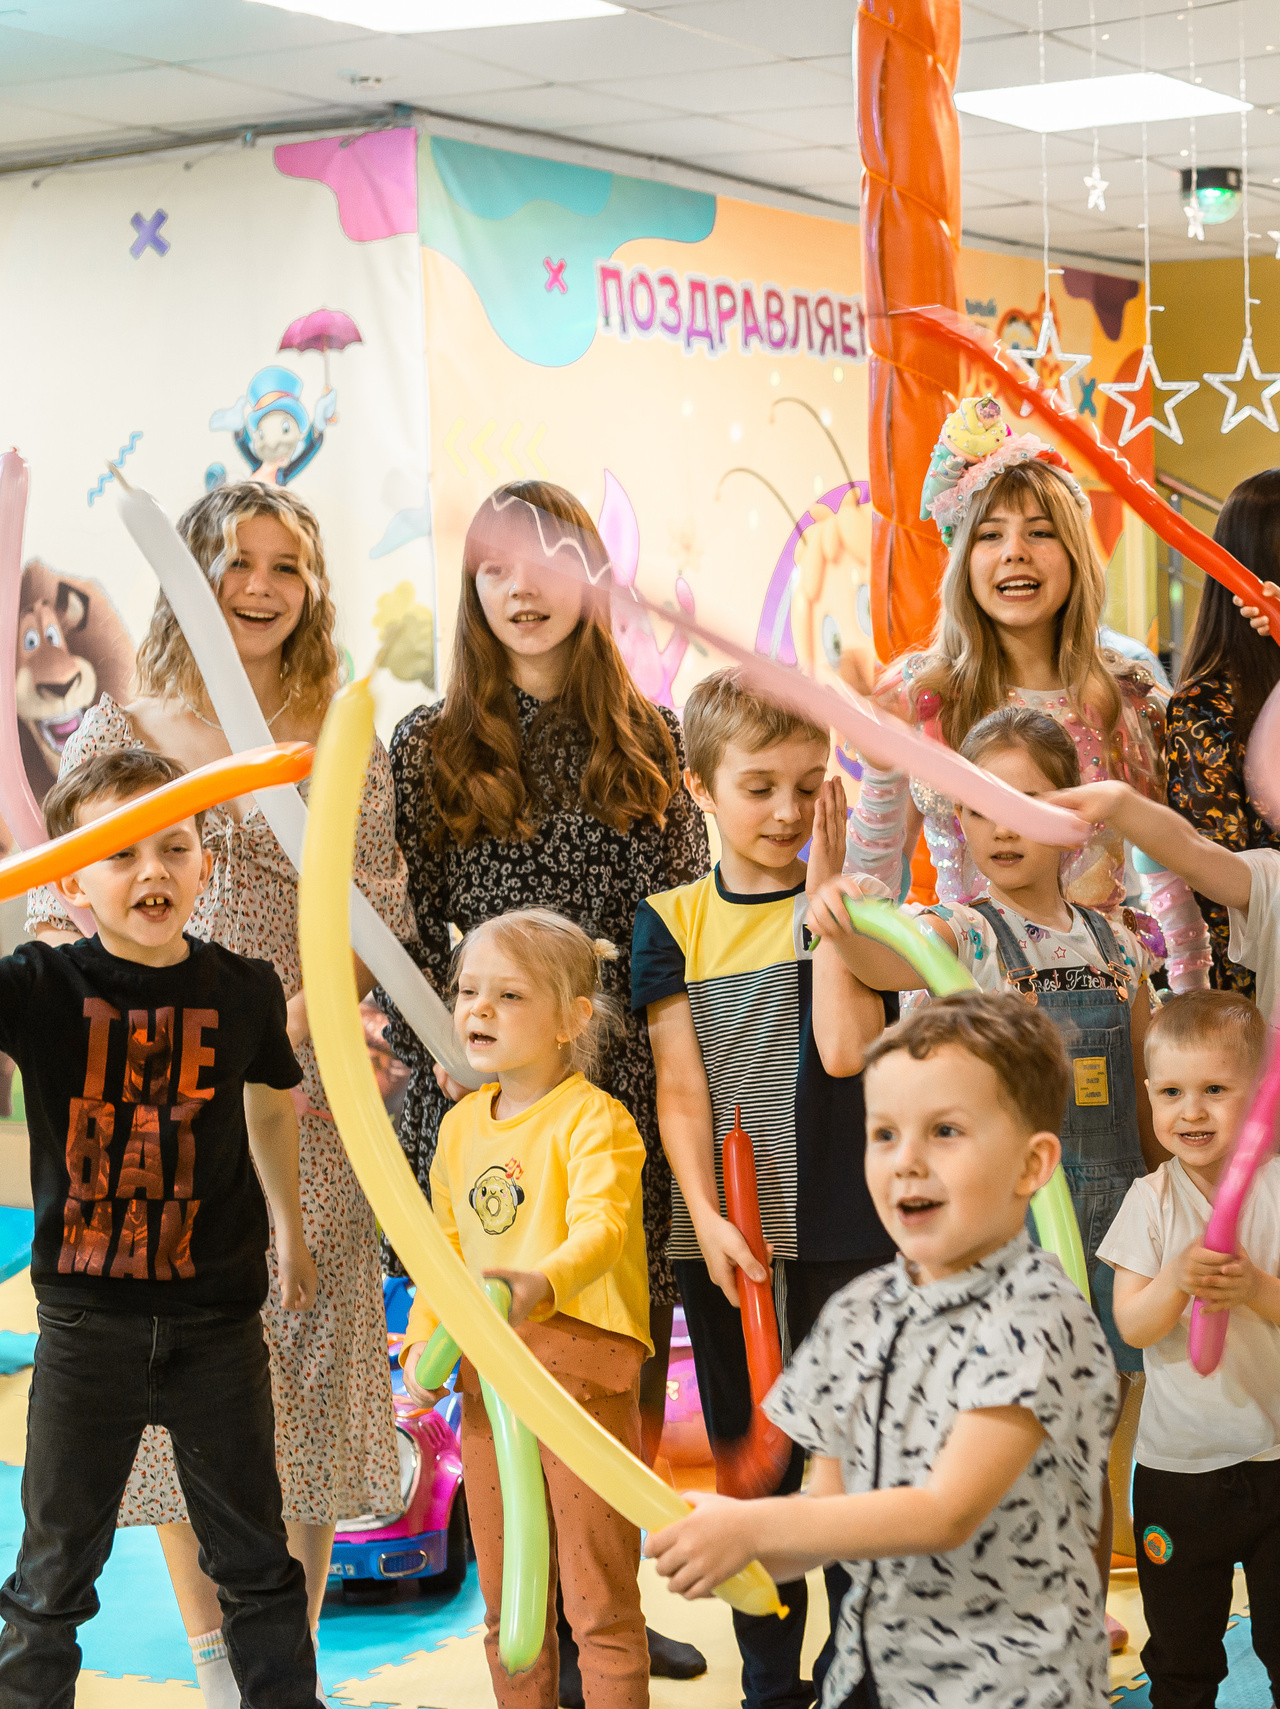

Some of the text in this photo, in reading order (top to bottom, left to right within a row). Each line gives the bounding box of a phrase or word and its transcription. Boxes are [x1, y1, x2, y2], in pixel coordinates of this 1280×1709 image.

[82, 998, 219, 1104] THE
[65, 1097, 205, 1200] BAT
[57, 1197, 200, 1281] MAN
